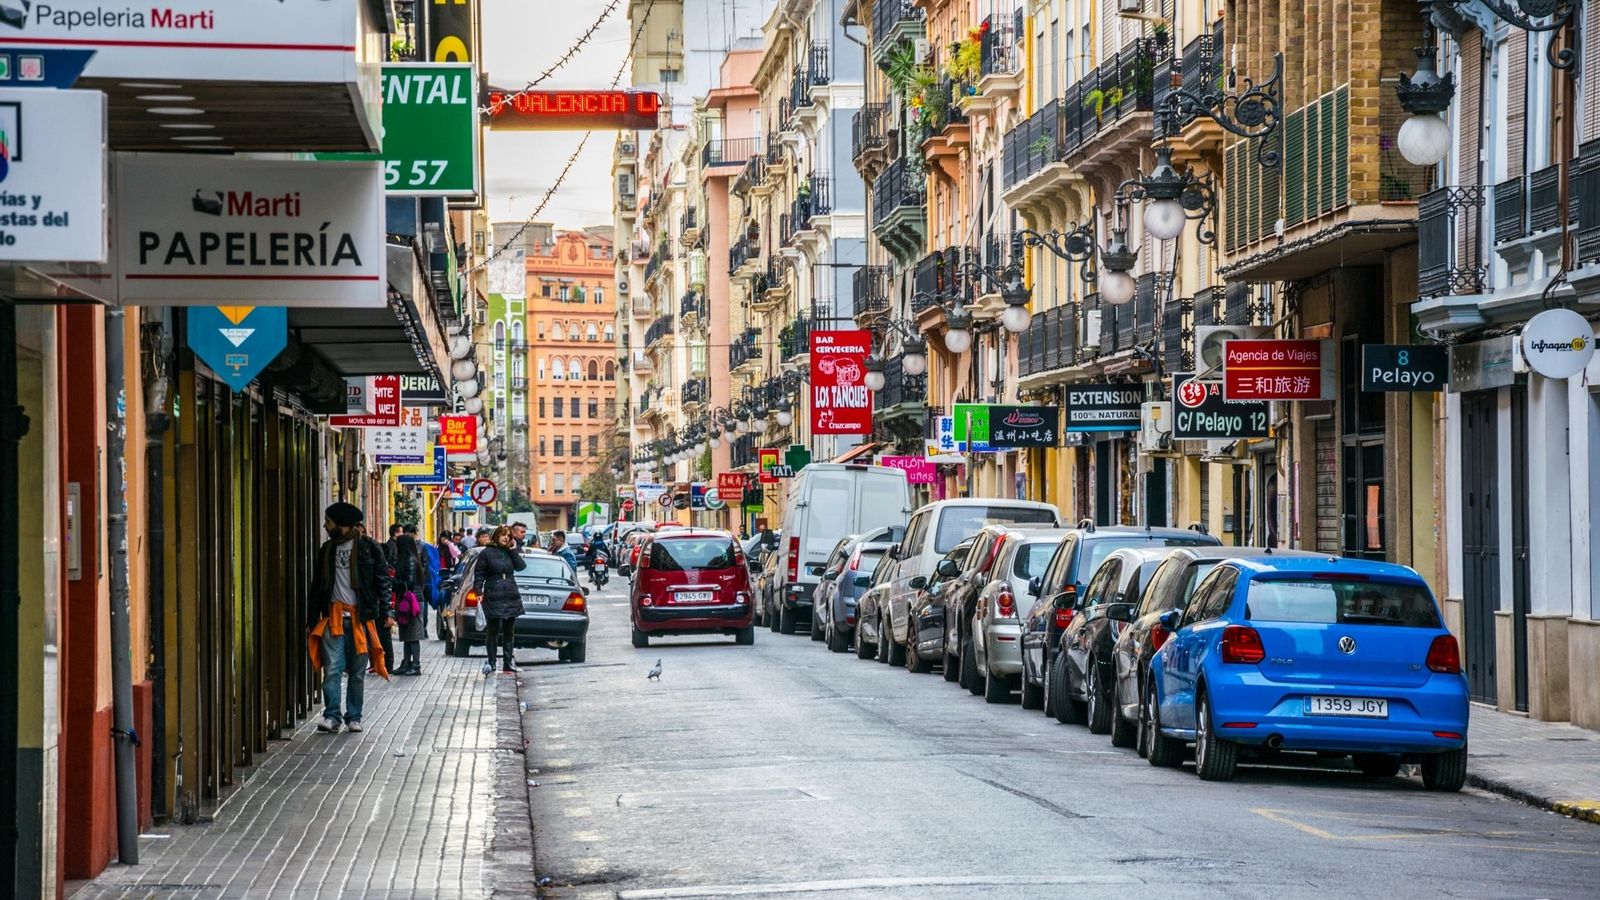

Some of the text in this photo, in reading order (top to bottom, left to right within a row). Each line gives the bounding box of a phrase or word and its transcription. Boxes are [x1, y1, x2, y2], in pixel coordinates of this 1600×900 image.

[36, 5, 214, 31] Papeleria Marti
[516, 95, 625, 112] VALENCIA
[409, 160, 448, 185] 57
[32, 195, 41, 210] y
[228, 191, 301, 217] Marti
[42, 211, 69, 226] del
[139, 222, 362, 266] PAPELERÍA
[815, 336, 834, 344] BAR
[1229, 349, 1318, 363] Agencia de Viajes
[1398, 350, 1409, 365] 8
[1236, 376, 1311, 394] 三和旅游
[1373, 368, 1435, 386] Pelayo
[815, 386, 868, 408] LOS TANQUES
[1070, 391, 1142, 405] EXTENSION
[1098, 411, 1139, 419] NATURAL
[447, 419, 466, 429] Bar
[1178, 412, 1266, 436] C/ Pelayo 12
[1316, 698, 1384, 713] 1359 JGY
